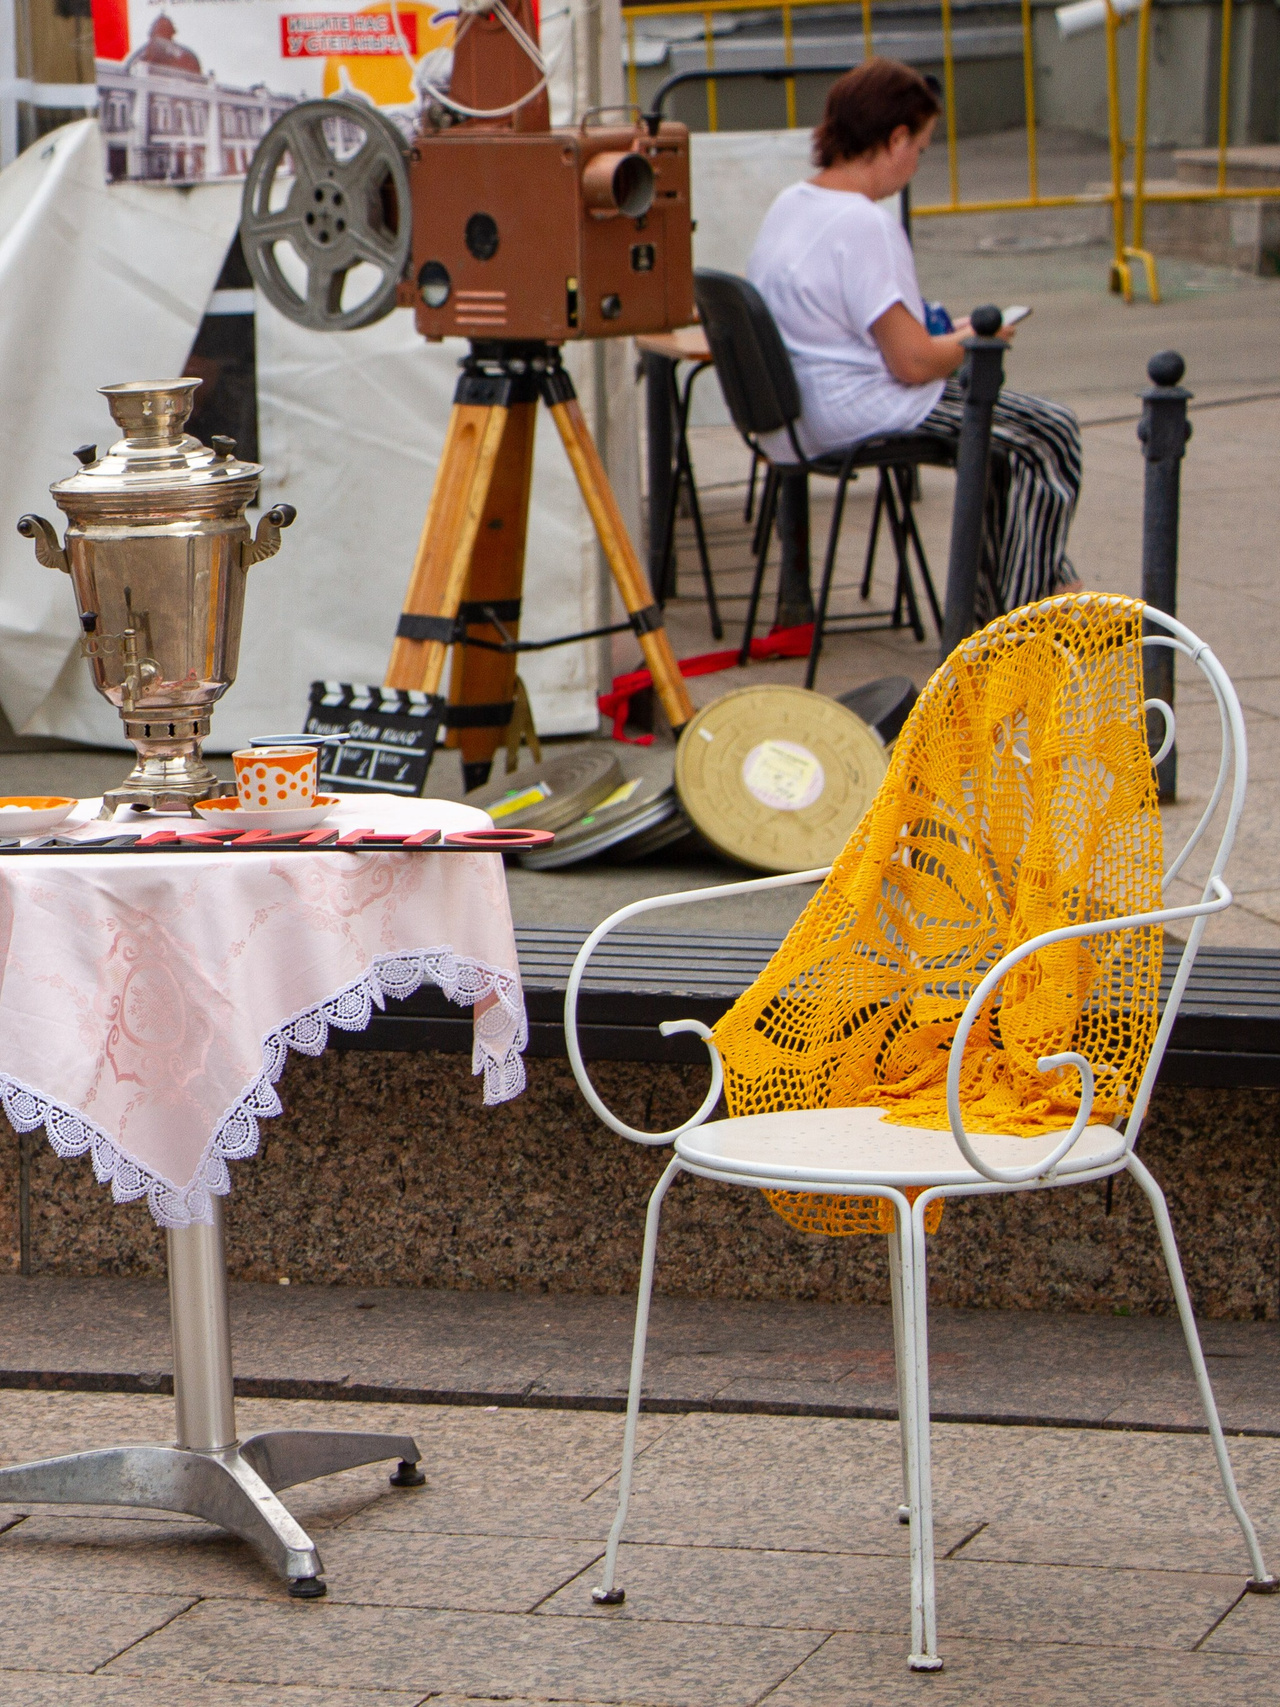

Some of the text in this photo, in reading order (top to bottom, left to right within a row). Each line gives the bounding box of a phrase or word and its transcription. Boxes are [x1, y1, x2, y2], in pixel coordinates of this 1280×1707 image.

[288, 16, 388, 33] ИЩИТЕ НАС
[288, 36, 303, 54] У
